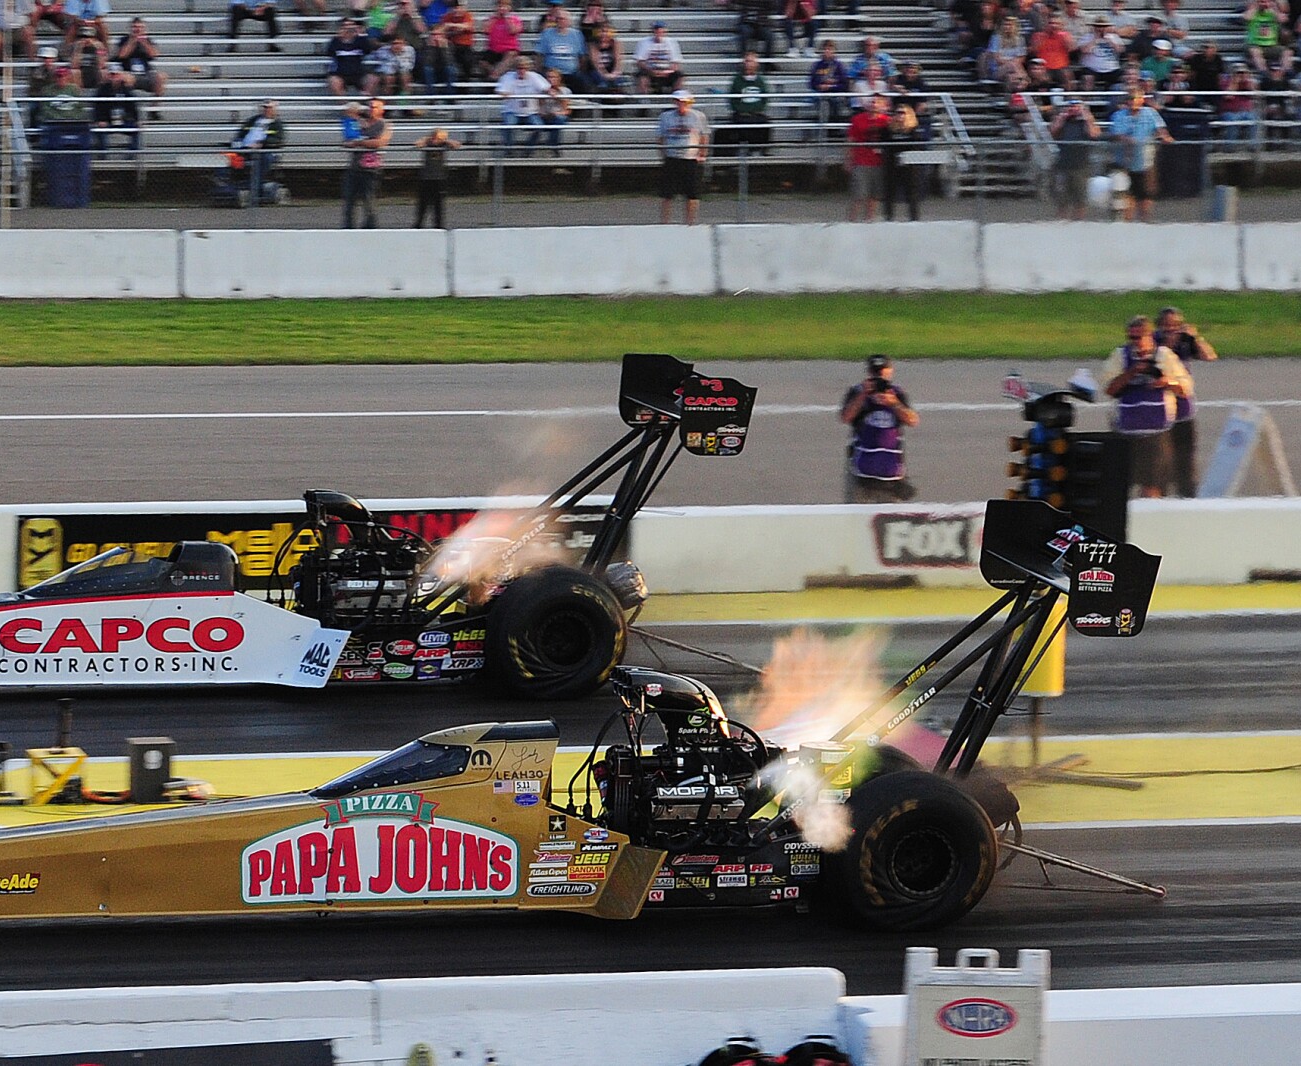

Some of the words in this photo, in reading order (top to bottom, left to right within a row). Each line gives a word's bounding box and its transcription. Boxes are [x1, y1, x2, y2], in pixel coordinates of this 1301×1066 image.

[684, 397, 738, 406] CAPCO
[884, 521, 965, 559] FOX
[1079, 543, 1089, 552] TF
[418, 632, 449, 645] CLEVITE
[453, 630, 485, 640] JEGS
[302, 643, 331, 666] MAC
[414, 649, 449, 657] ARP
[448, 659, 476, 668] XRP
[299, 665, 326, 678] TOOLS
[905, 665, 927, 686] JEGS
[887, 687, 936, 730] GOODYEAR
[346, 795, 414, 812] PIZZA
[248, 826, 361, 897] PAPA
[369, 824, 511, 893] JOHN'S
[575, 853, 610, 864] JEGS
[529, 868, 548, 876] Atlas
[549, 868, 567, 876] Copco
[712, 865, 744, 873] ARP
[533, 886, 590, 894] FREIGHTLINER
[786, 888, 797, 896] CV
[651, 892, 662, 900] CV
